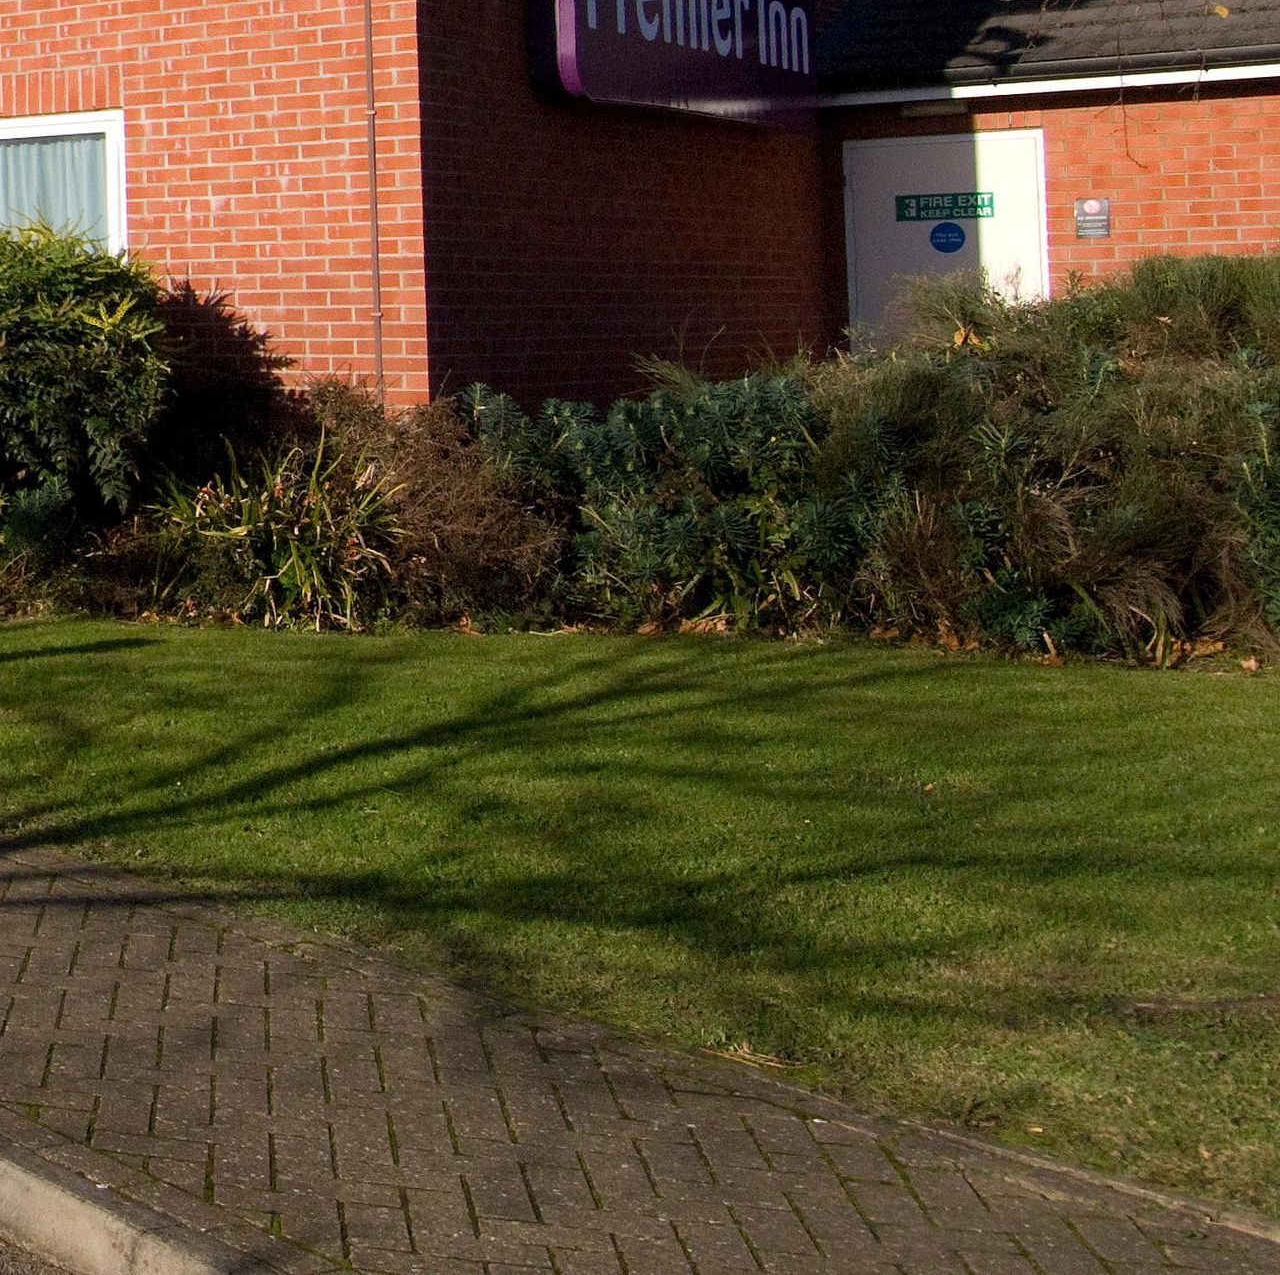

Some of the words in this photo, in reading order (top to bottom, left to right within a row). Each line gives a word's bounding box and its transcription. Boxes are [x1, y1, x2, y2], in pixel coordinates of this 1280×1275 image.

[921, 196, 953, 208] FIRE
[957, 194, 992, 207] EXIT
[921, 209, 950, 218] KEEP
[953, 207, 992, 217] CLEAR
